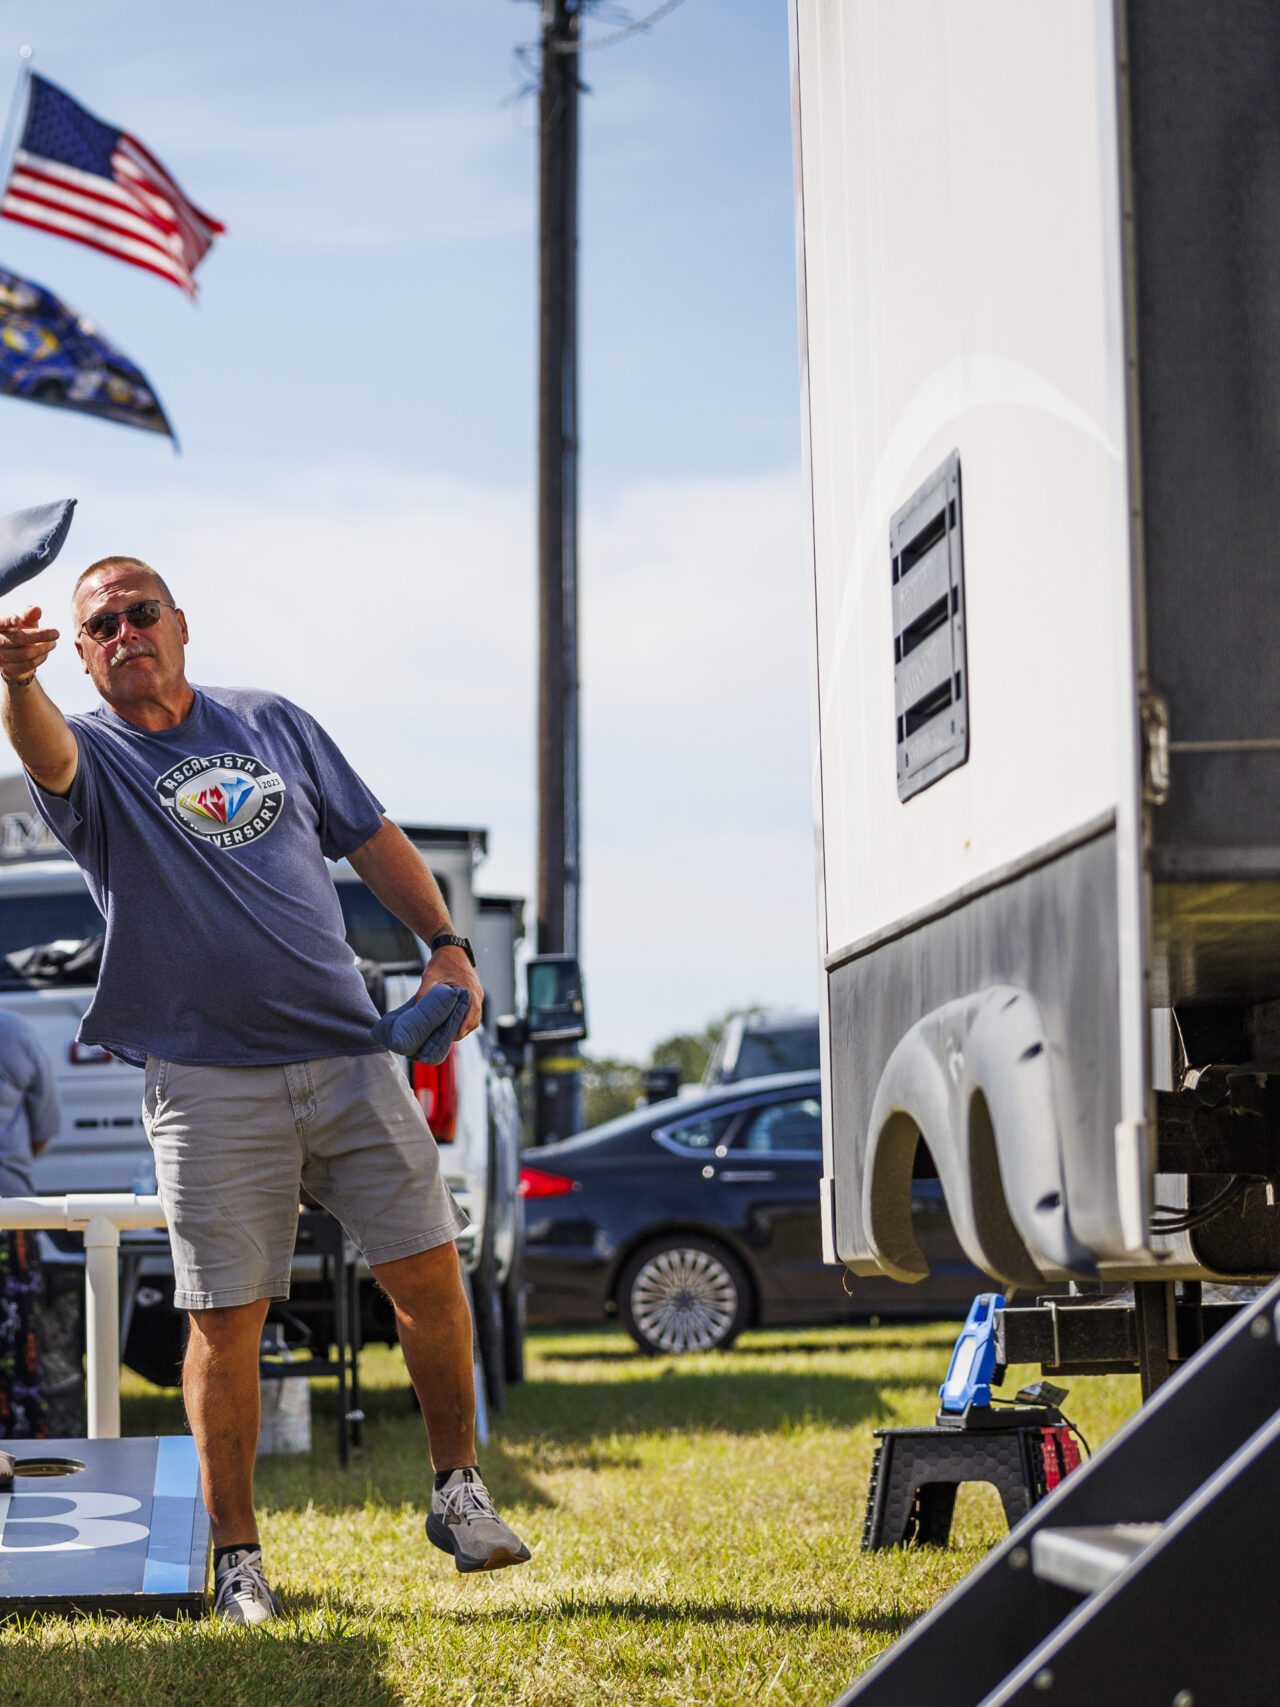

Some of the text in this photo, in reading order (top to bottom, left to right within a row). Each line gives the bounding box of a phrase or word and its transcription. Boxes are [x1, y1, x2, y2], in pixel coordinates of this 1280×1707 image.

[162, 756, 256, 791] ASCAR 75TH
[262, 778, 281, 789] 2023
